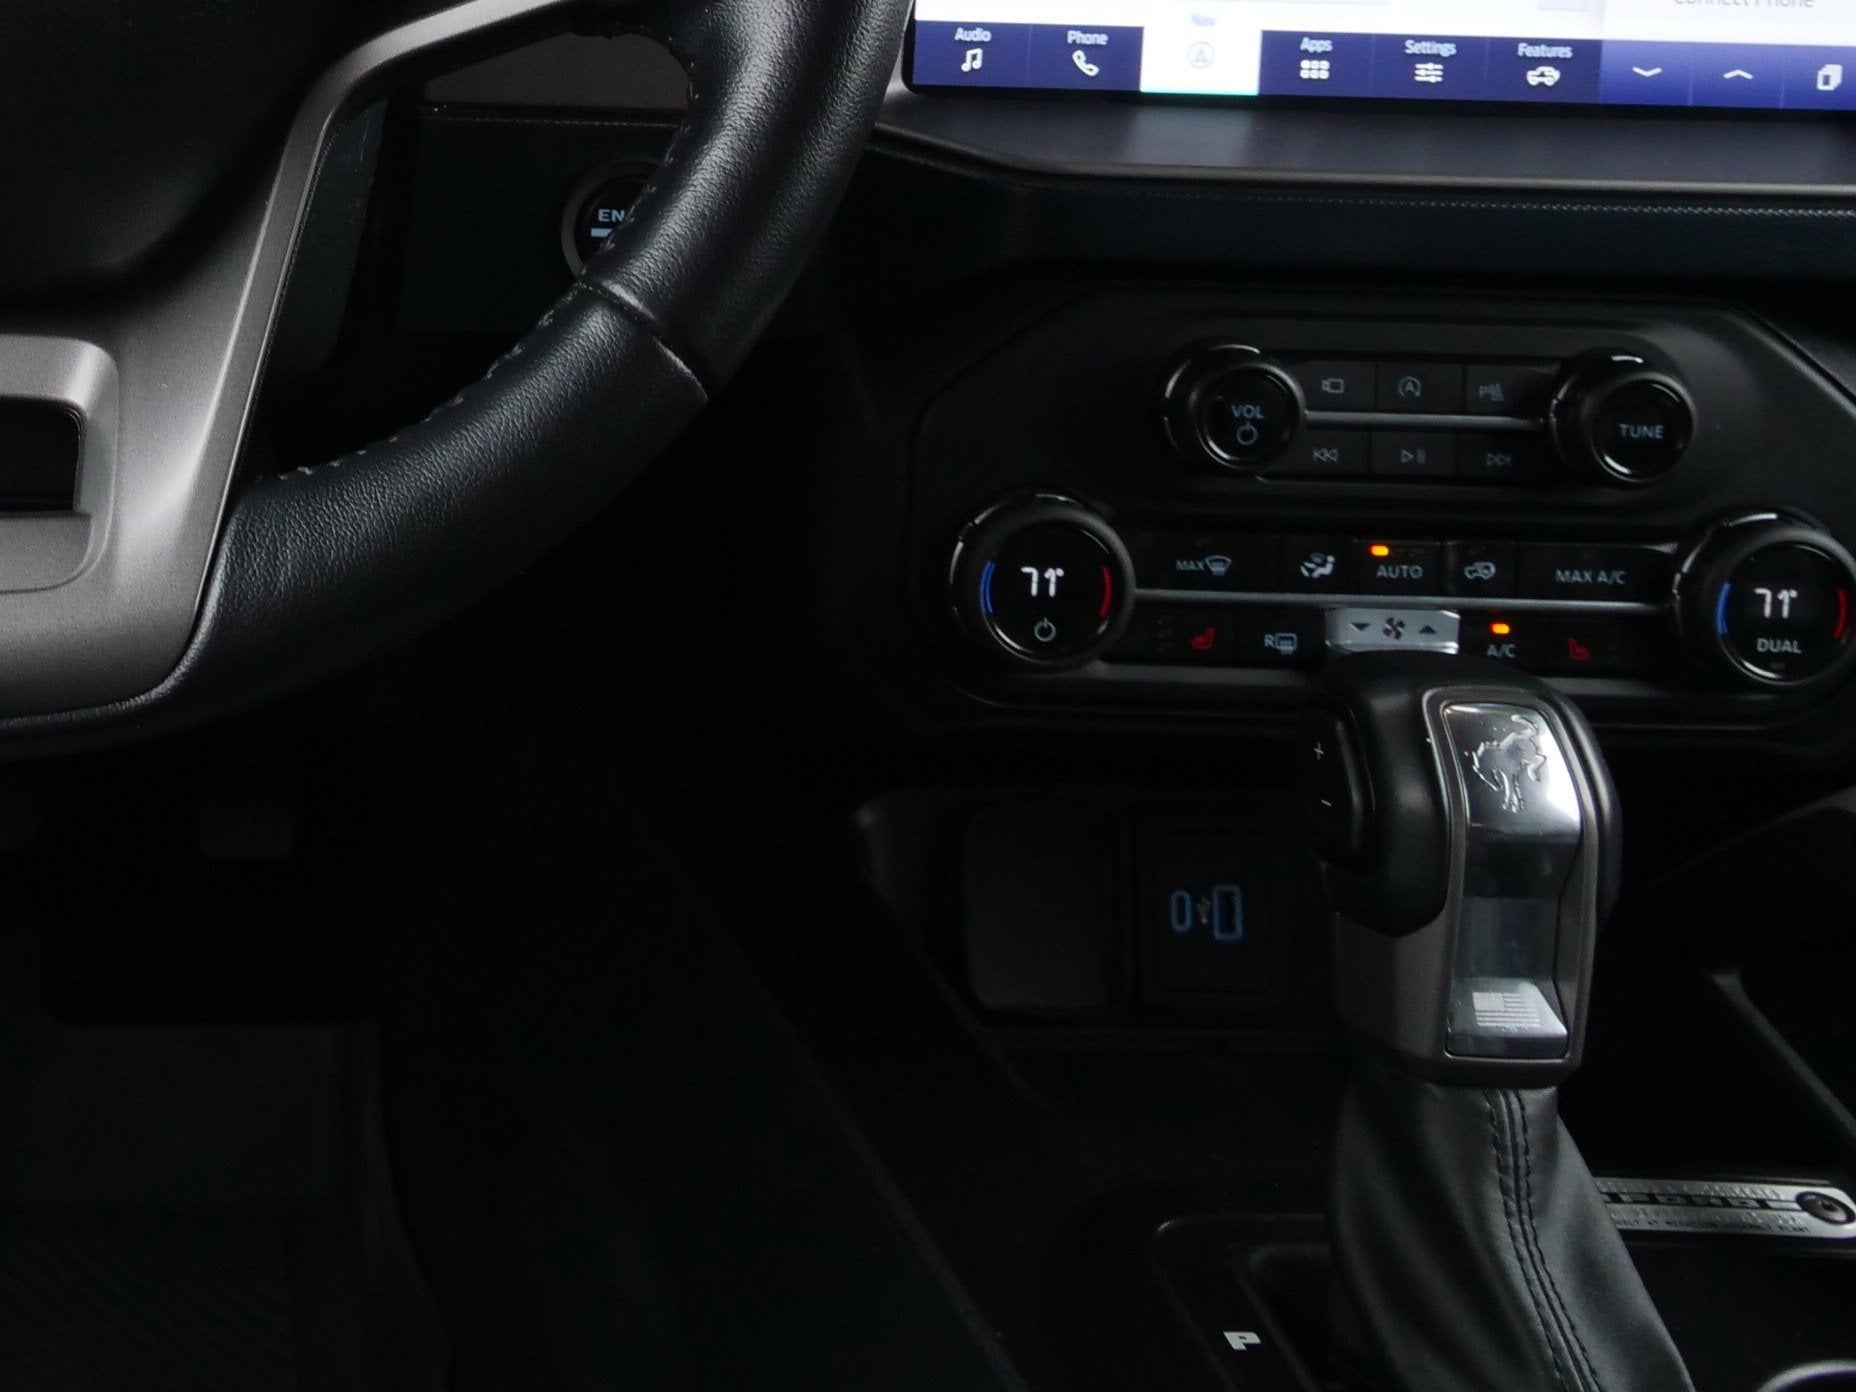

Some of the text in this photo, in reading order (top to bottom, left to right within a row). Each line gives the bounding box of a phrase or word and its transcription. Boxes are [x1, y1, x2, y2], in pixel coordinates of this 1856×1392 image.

[954, 26, 992, 43] Audio
[1066, 29, 1109, 46] Phone
[1300, 37, 1333, 54] Apps
[1405, 39, 1457, 58] Settings
[1517, 42, 1573, 59] Features
[597, 208, 626, 223] EN
[1231, 403, 1265, 420] VOL
[1618, 423, 1665, 440] TUNE
[1376, 563, 1423, 580] AUTO
[1555, 568, 1628, 585] MAX A/C
[1486, 642, 1517, 660] A/C
[1756, 637, 1803, 655] DUAL
[1222, 1330, 1262, 1351] P
